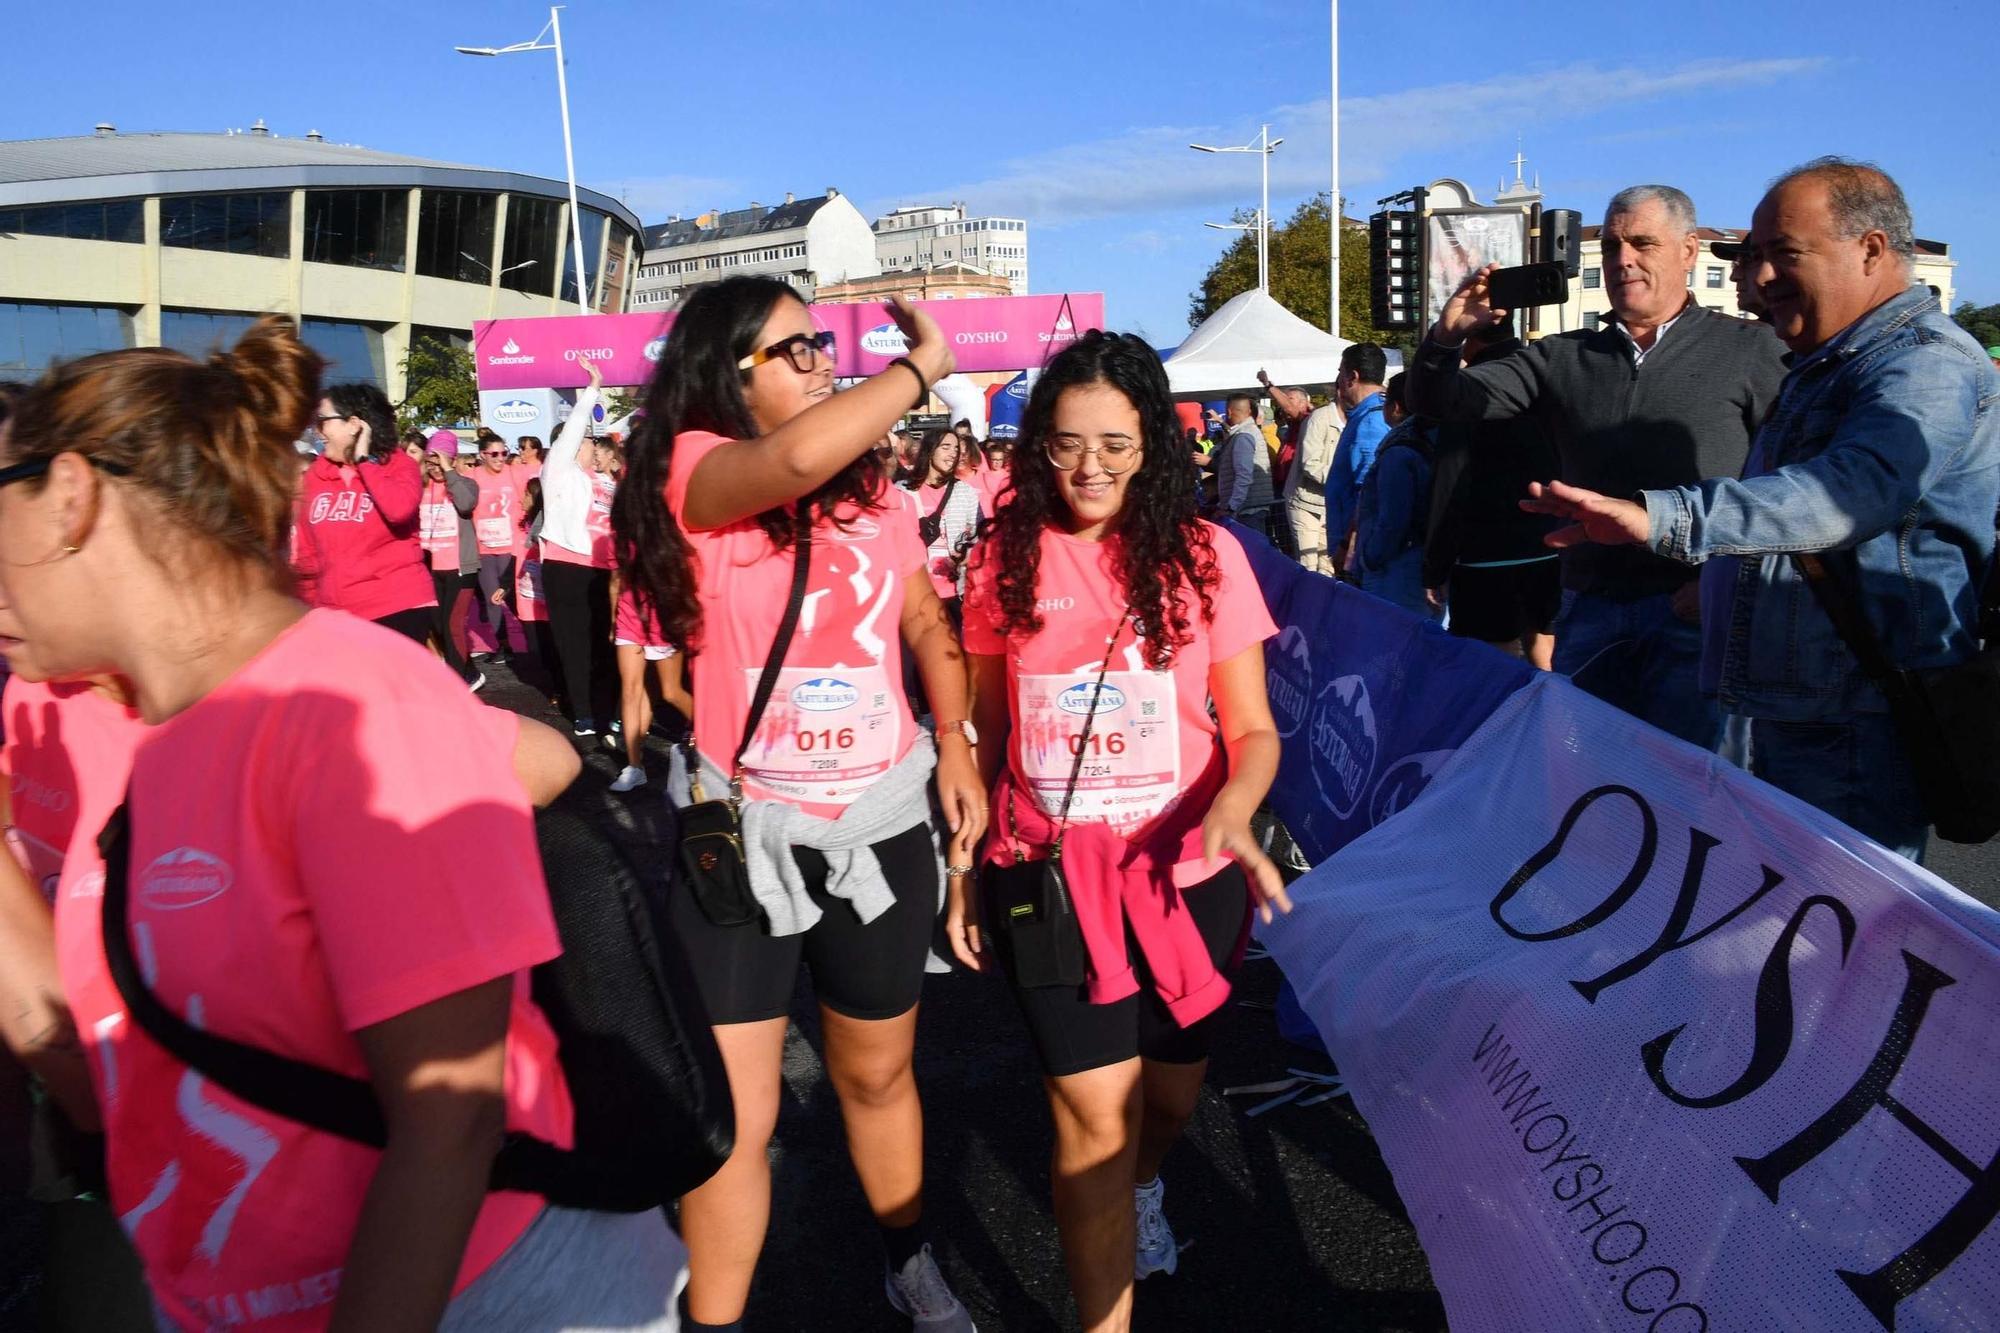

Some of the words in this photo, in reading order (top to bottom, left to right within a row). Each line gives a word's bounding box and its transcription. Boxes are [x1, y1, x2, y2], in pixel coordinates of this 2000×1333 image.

[866, 336, 901, 347] ASTURI
[956, 331, 1008, 344] OYSHO
[488, 355, 536, 365] Santander
[309, 491, 374, 525] GAP
[1036, 596, 1075, 611] SHO
[1062, 695, 1121, 708] ASTUIANA
[798, 728, 854, 751] 016
[1068, 732, 1125, 756] 016
[1083, 766, 1111, 776] 7204
[1490, 784, 2000, 1333] OYSH
